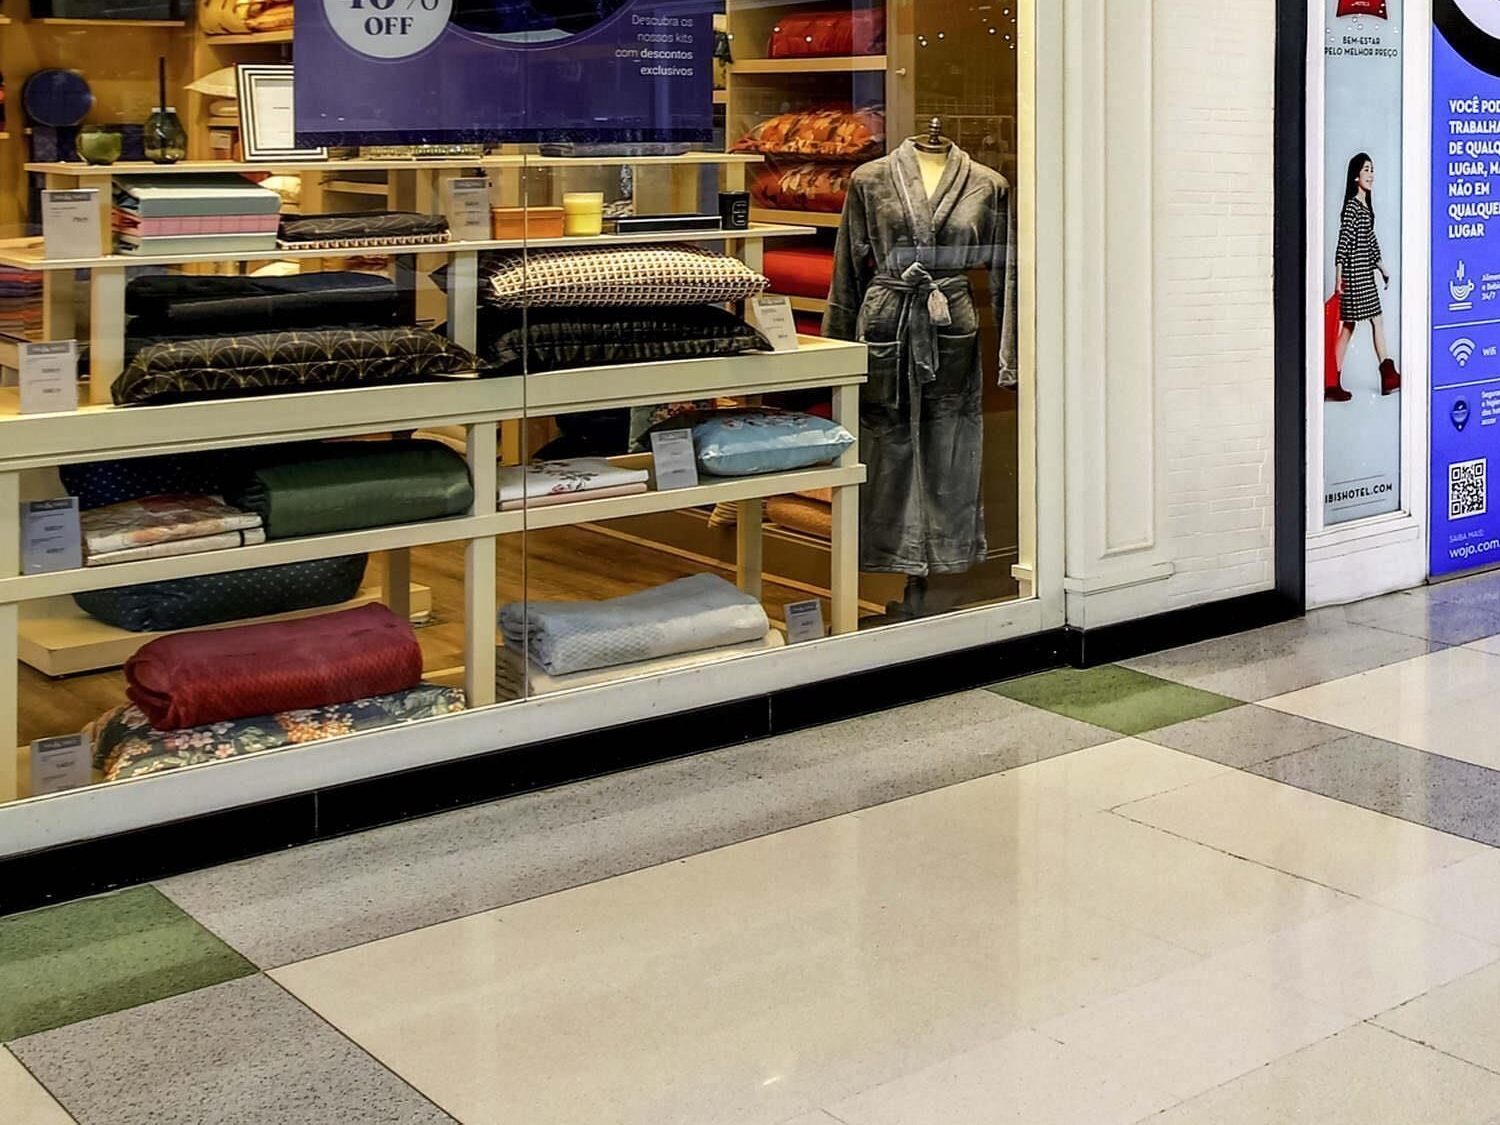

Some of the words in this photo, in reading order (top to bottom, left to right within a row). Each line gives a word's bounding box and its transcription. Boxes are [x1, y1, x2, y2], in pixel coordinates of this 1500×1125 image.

[364, 16, 414, 36] OFF
[632, 14, 679, 27] Descubra
[680, 18, 694, 27] os
[637, 33, 674, 43] nossos
[675, 32, 693, 44] kits
[615, 49, 638, 58] com
[640, 48, 693, 60] descontos
[640, 64, 693, 76] exclusivos
[1449, 96, 1479, 113] VOCÊ
[1449, 142, 1463, 155] DE
[1449, 162, 1487, 177] LUGAR,
[1449, 179, 1472, 196] NÃO
[1475, 183, 1490, 195] EM
[1449, 224, 1484, 238] LUGAR
[1325, 483, 1392, 504] IBISHOTEL.COM
